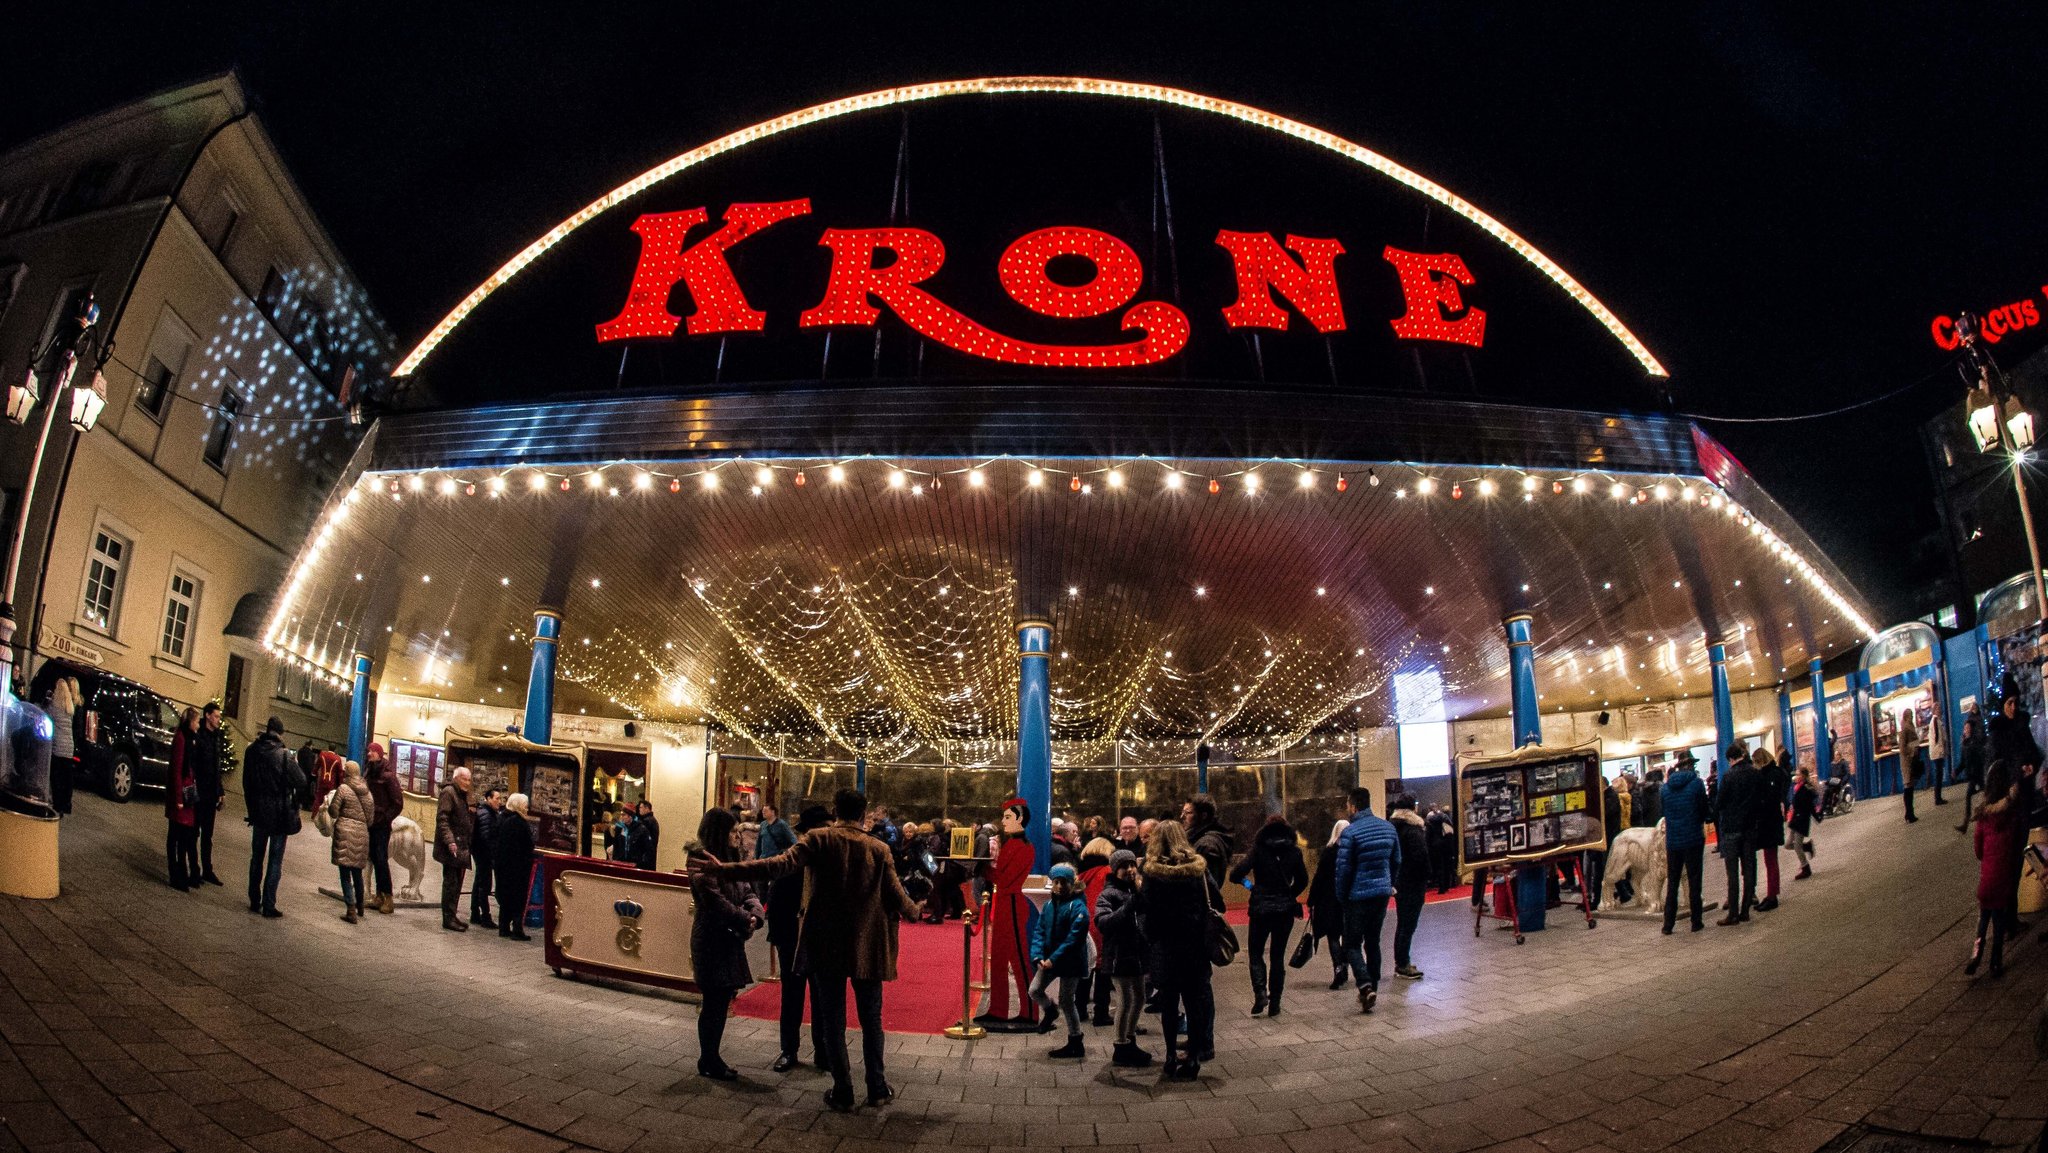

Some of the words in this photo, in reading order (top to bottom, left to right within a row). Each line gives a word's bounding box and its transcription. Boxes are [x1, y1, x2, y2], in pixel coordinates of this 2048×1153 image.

[596, 198, 1488, 368] KRONE
[1931, 299, 2040, 351] CCUS
[53, 635, 71, 653] ZOO
[954, 835, 969, 850] VIP
